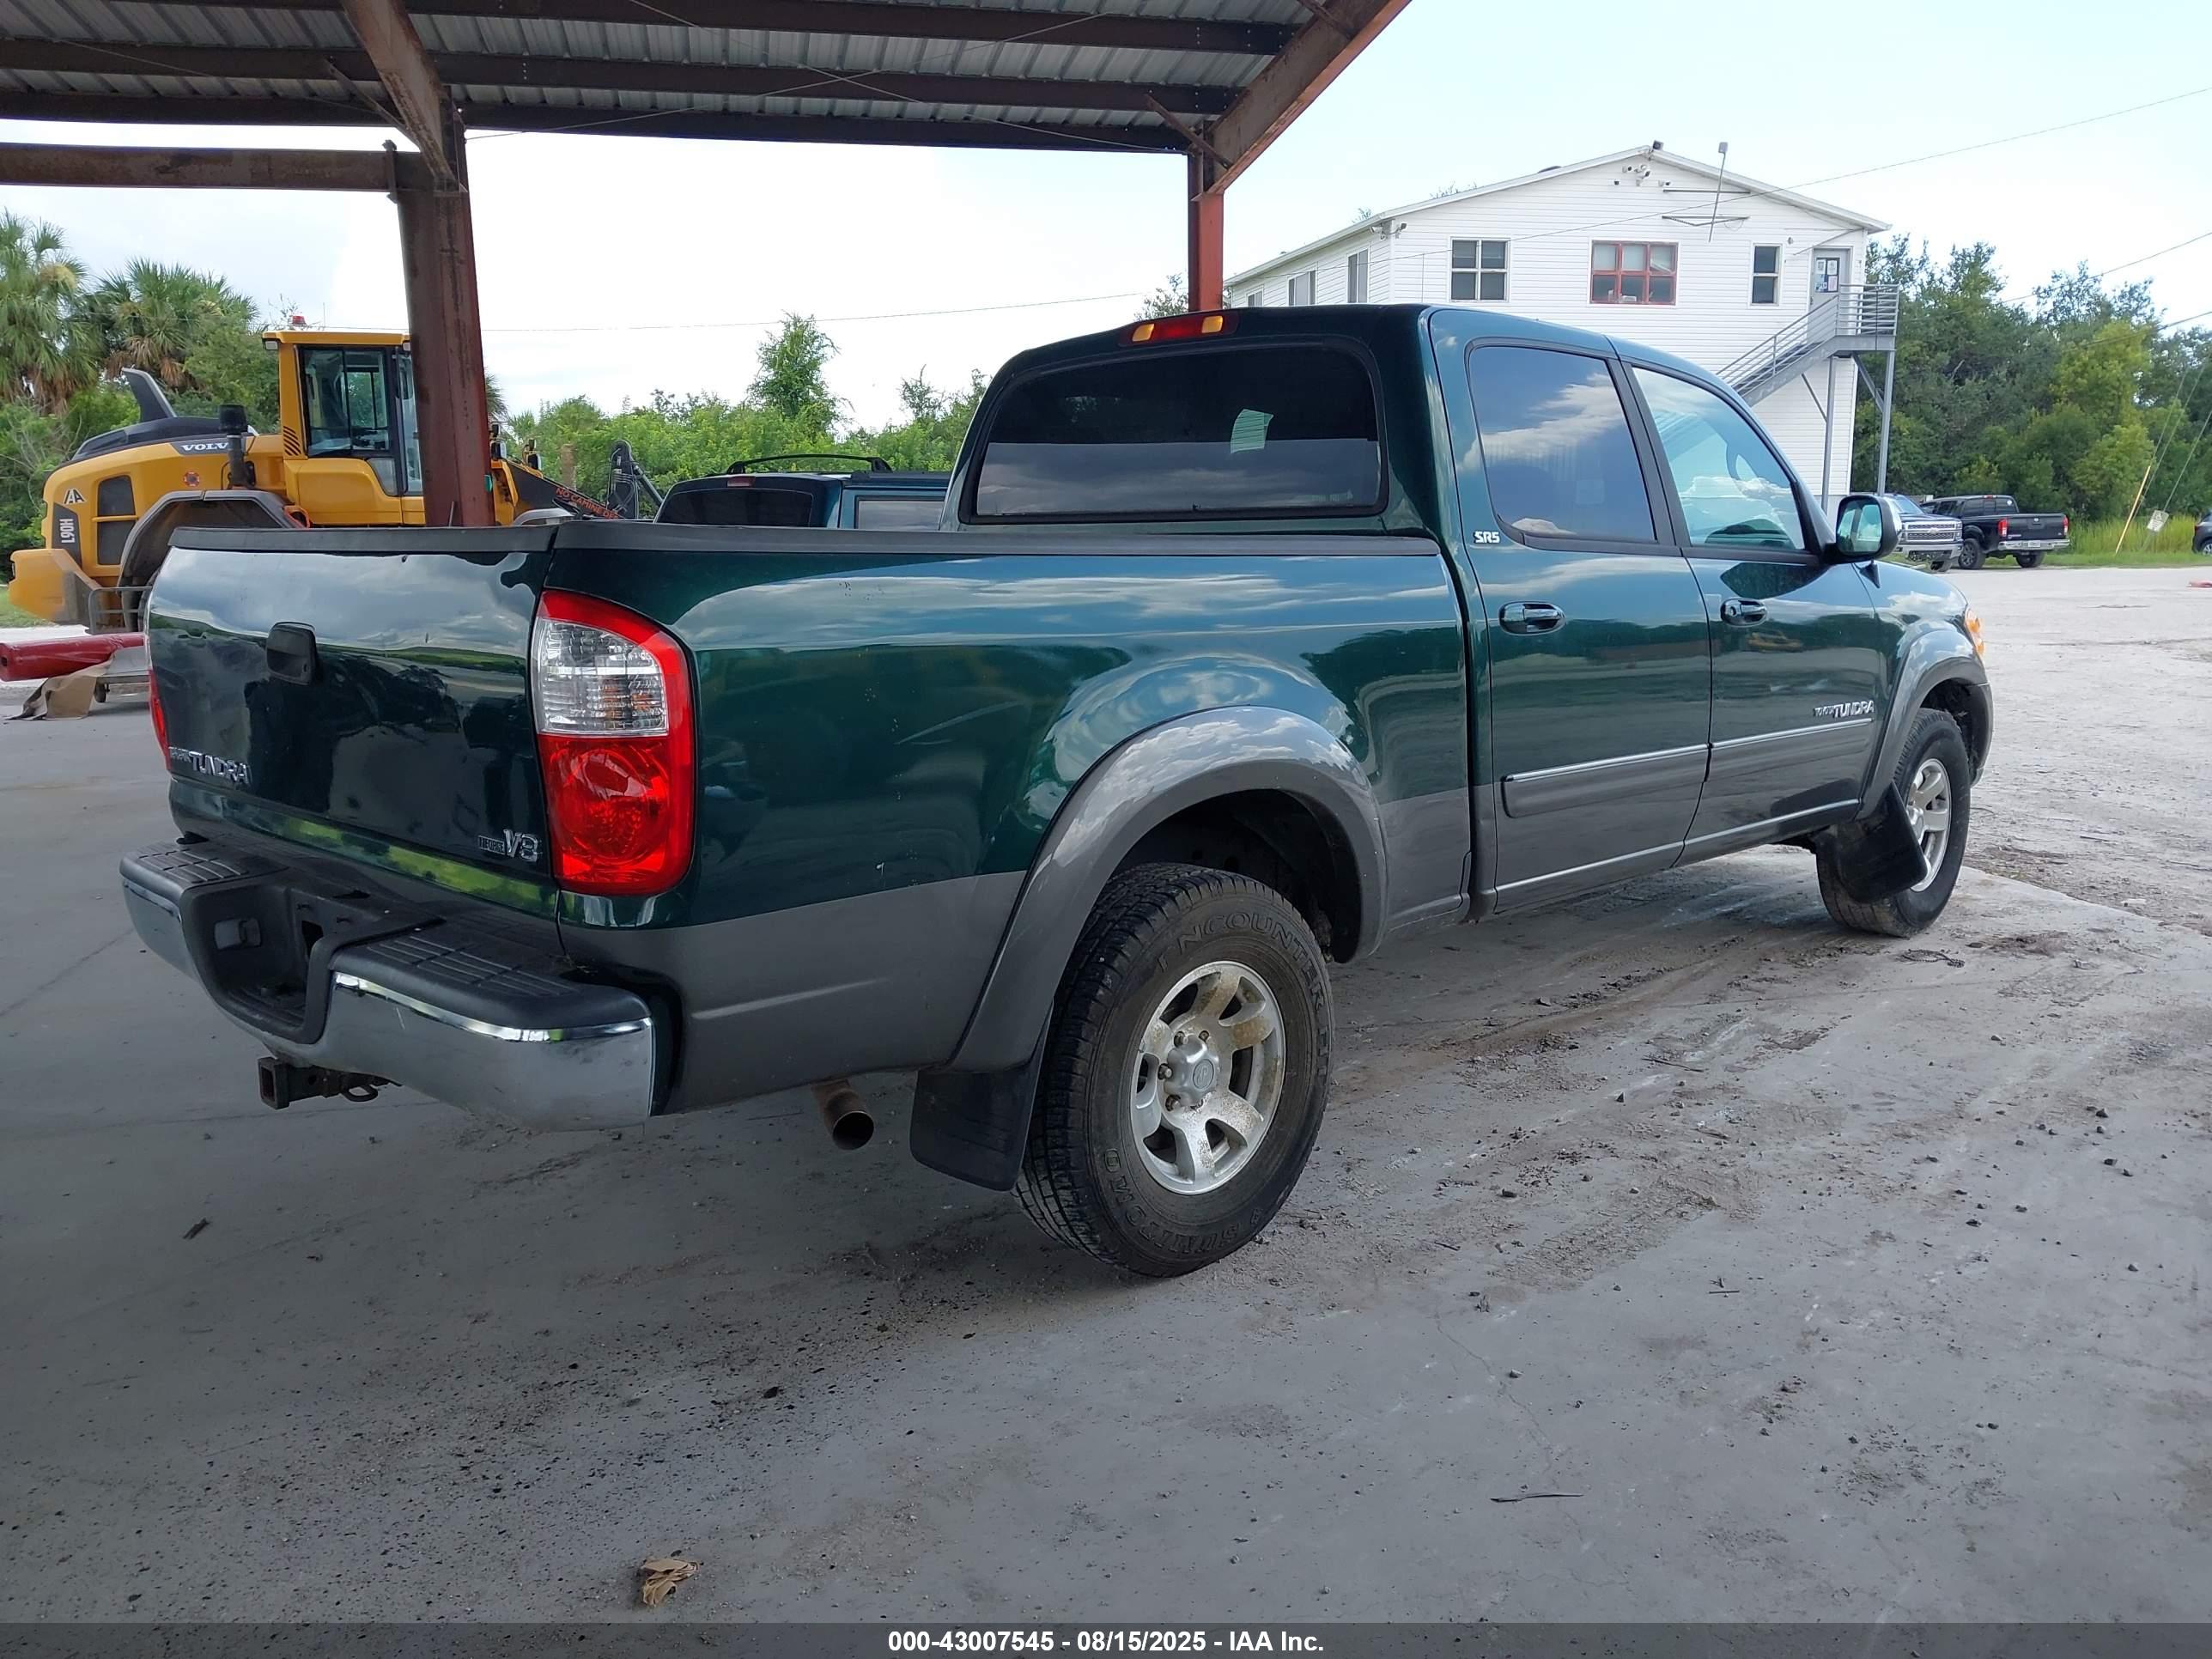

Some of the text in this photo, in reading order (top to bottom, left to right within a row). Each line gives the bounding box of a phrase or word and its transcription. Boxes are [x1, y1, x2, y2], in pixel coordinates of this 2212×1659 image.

[179, 441, 229, 452] VOLV
[556, 488, 570, 498] NO
[59, 519, 75, 543] L90H
[1474, 531, 1500, 544] SR5
[1833, 700, 1875, 718] TUNDRA
[189, 750, 252, 784] TUNDRA
[503, 829, 539, 862] V8
